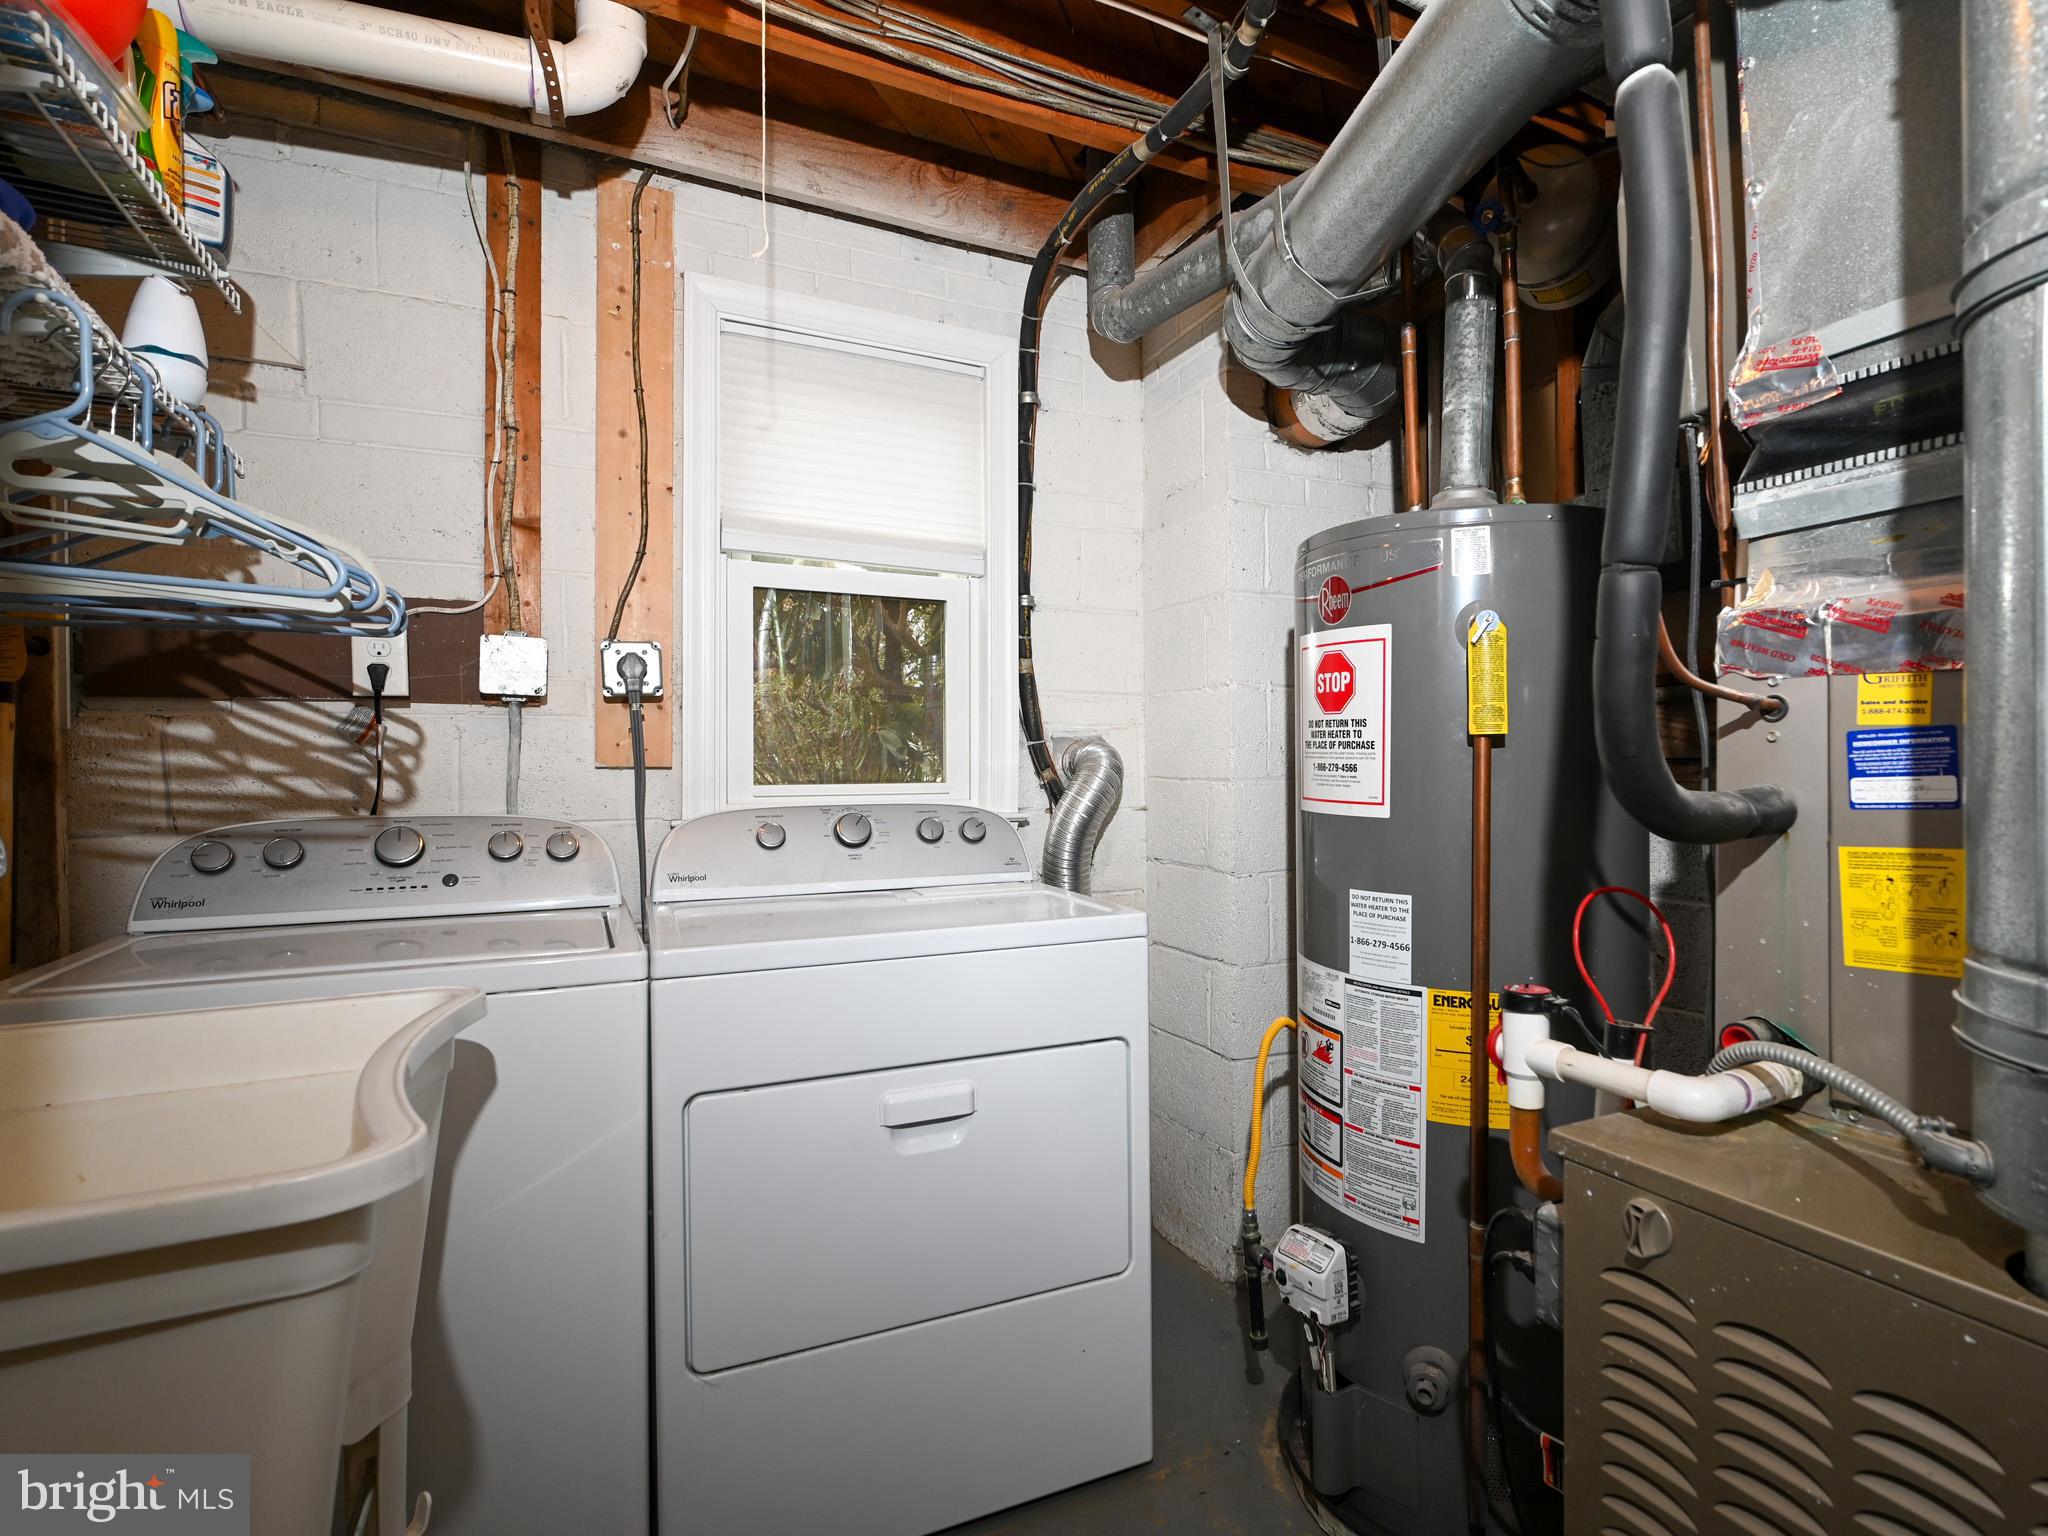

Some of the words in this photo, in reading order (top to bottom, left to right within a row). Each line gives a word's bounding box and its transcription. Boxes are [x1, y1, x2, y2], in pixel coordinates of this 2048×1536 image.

[256, 0, 304, 17] EAGLE
[1322, 577, 1349, 618] Rheem
[1730, 639, 1770, 656] WEATHER
[1770, 650, 1796, 662] COLD
[1317, 671, 1350, 694] STOP
[1308, 720, 1314, 728] DO
[1315, 720, 1324, 728] NOT
[1325, 719, 1349, 728] RETURN
[1351, 718, 1367, 728] THIS
[1311, 730, 1326, 739] WATER
[1328, 730, 1351, 738] HEATER
[1353, 730, 1362, 738] TO
[1313, 741, 1327, 749] PLACE
[1329, 741, 1336, 749] OF
[1338, 741, 1375, 749] PURCHASE
[1313, 763, 1358, 772] 1-866-279-4566
[669, 874, 706, 883] Whirlpool
[152, 898, 205, 910] Whirlpool
[1377, 913, 1406, 922] PURCHASE
[1350, 936, 1410, 952] 1-866-279-4566
